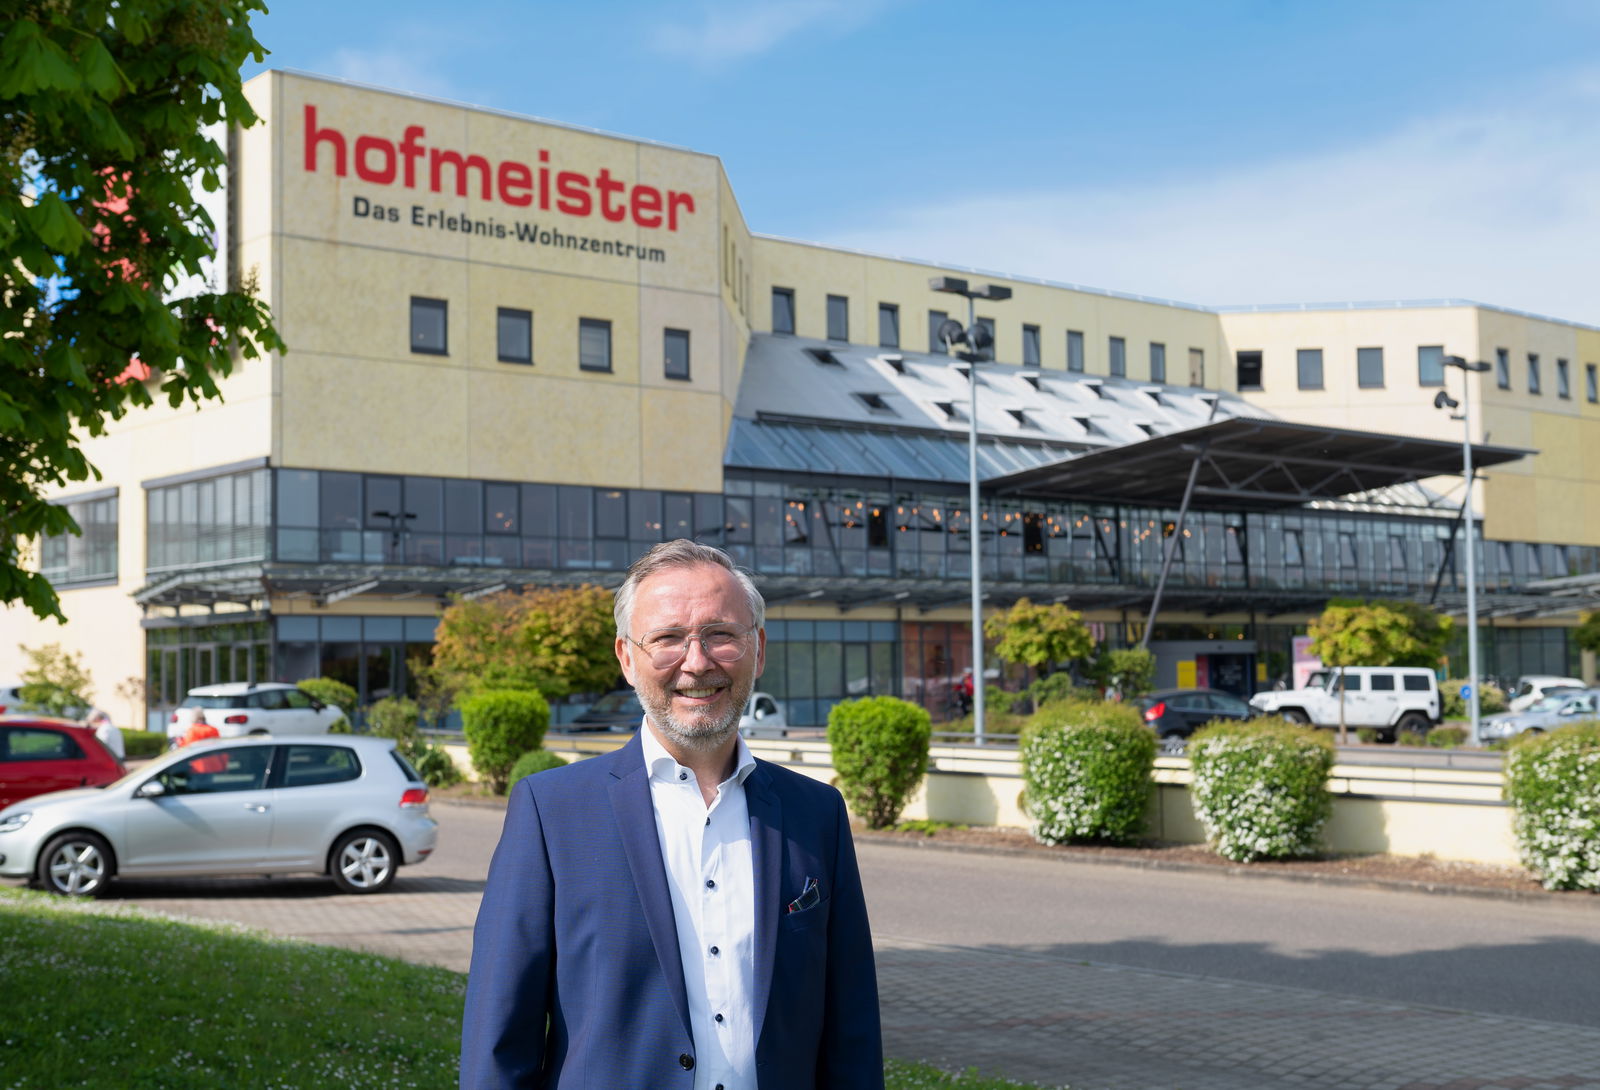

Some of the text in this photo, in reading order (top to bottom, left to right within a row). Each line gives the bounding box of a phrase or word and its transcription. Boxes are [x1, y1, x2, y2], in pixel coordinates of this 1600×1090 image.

[304, 104, 695, 232] hofmeister
[353, 196, 666, 263] Das Erlebnis-Wohnzentrum
